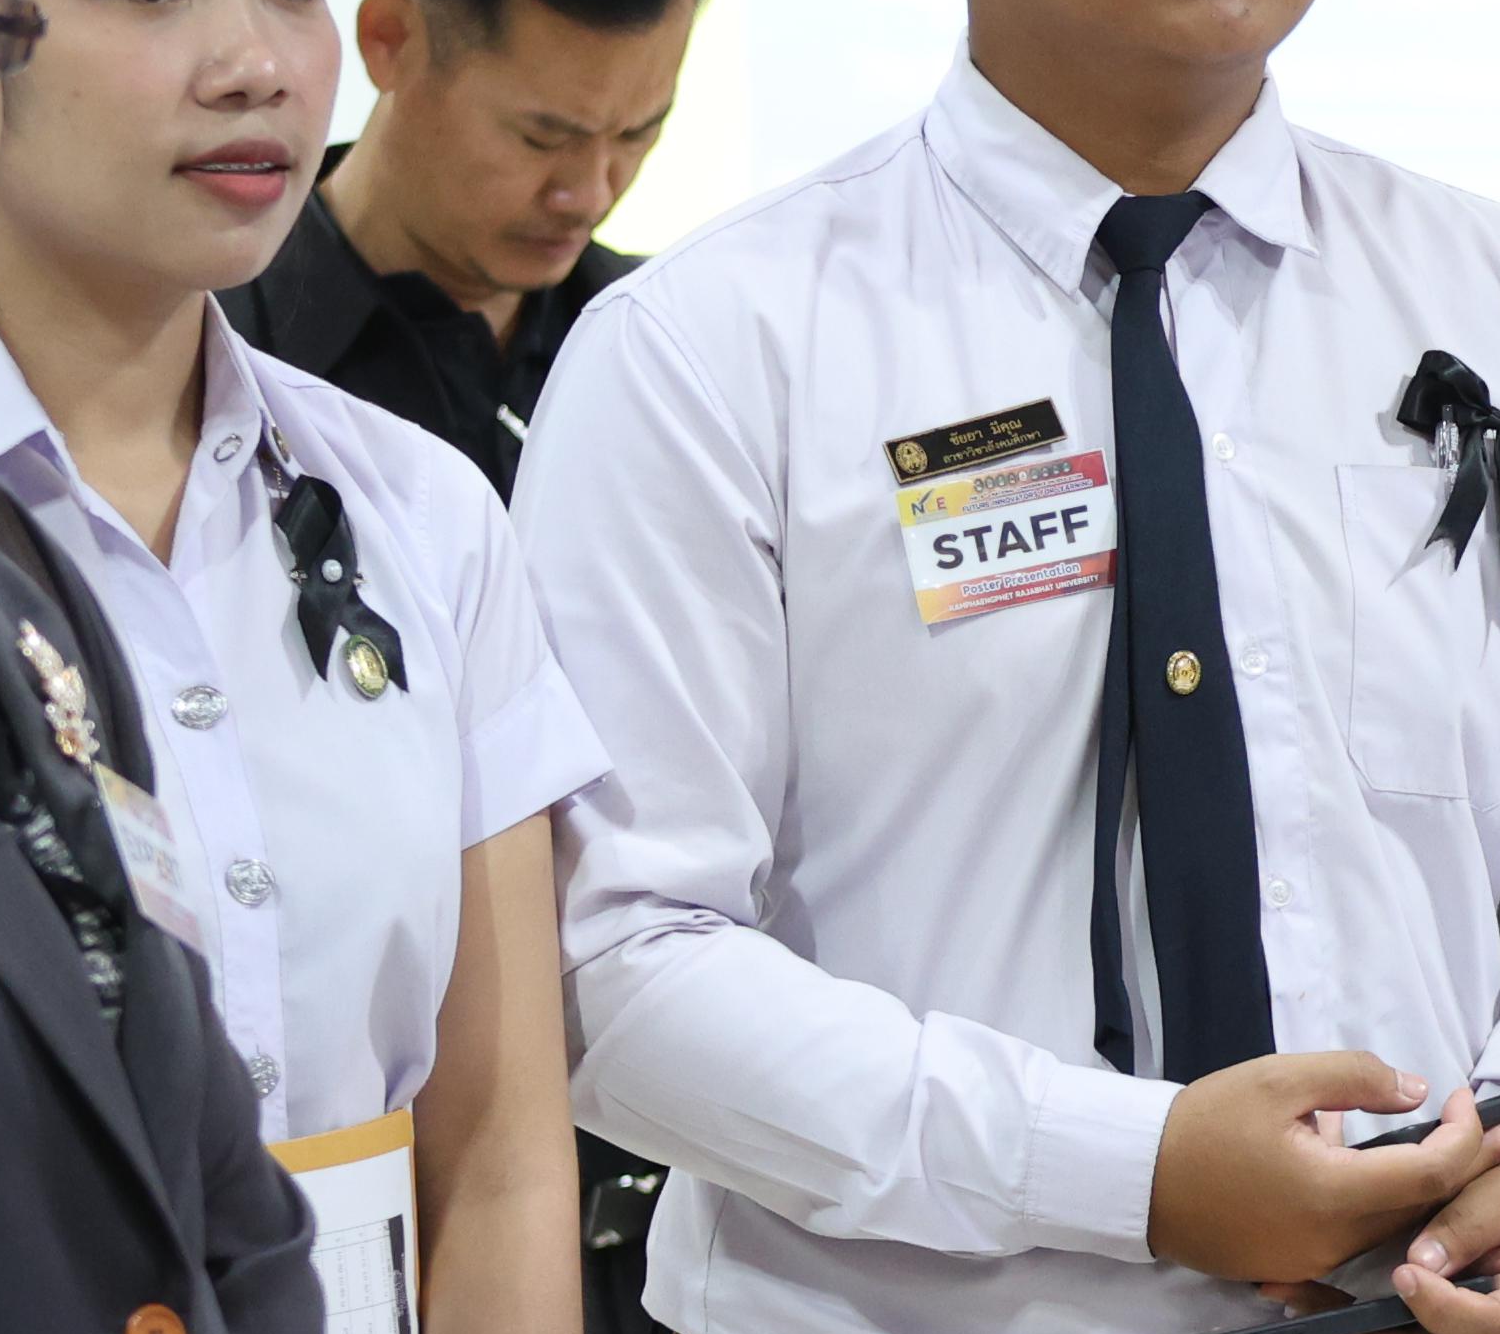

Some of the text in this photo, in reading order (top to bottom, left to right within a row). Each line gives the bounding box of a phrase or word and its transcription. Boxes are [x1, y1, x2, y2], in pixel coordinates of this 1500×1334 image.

[933, 505, 1089, 570] STAFF
[963, 562, 1080, 596] Poster Presentation
[1055, 574, 1099, 590] UNIVERSITY
